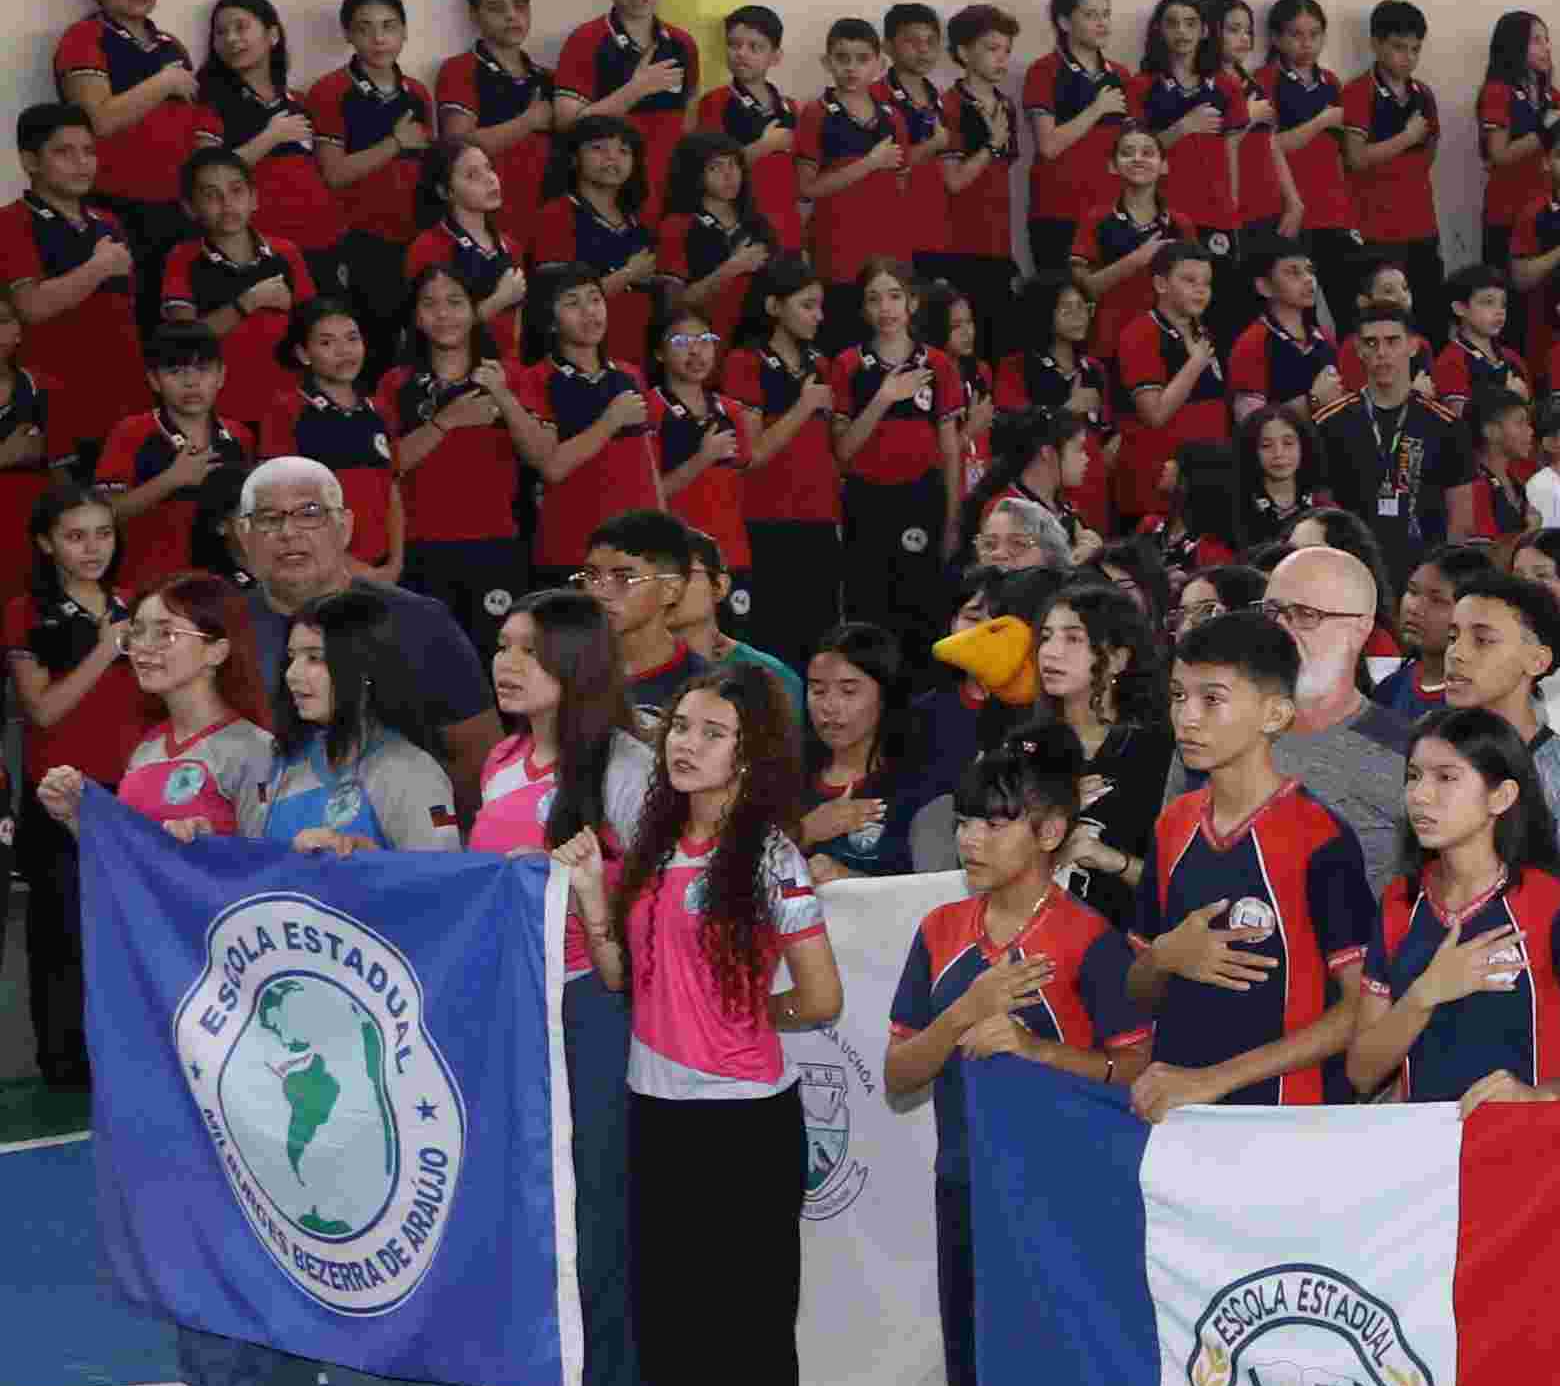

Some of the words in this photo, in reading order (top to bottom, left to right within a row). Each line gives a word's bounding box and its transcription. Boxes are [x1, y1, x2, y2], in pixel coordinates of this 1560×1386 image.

[199, 921, 277, 1037] ESCOLA
[282, 920, 417, 1075] ESTADUAL
[292, 1243, 386, 1295] BEZERRA
[383, 1239, 413, 1279] DE
[402, 1146, 448, 1257] ARAÚJO
[1212, 1278, 1289, 1348] ESCOLA
[1296, 1277, 1394, 1369] ESTADUAL
